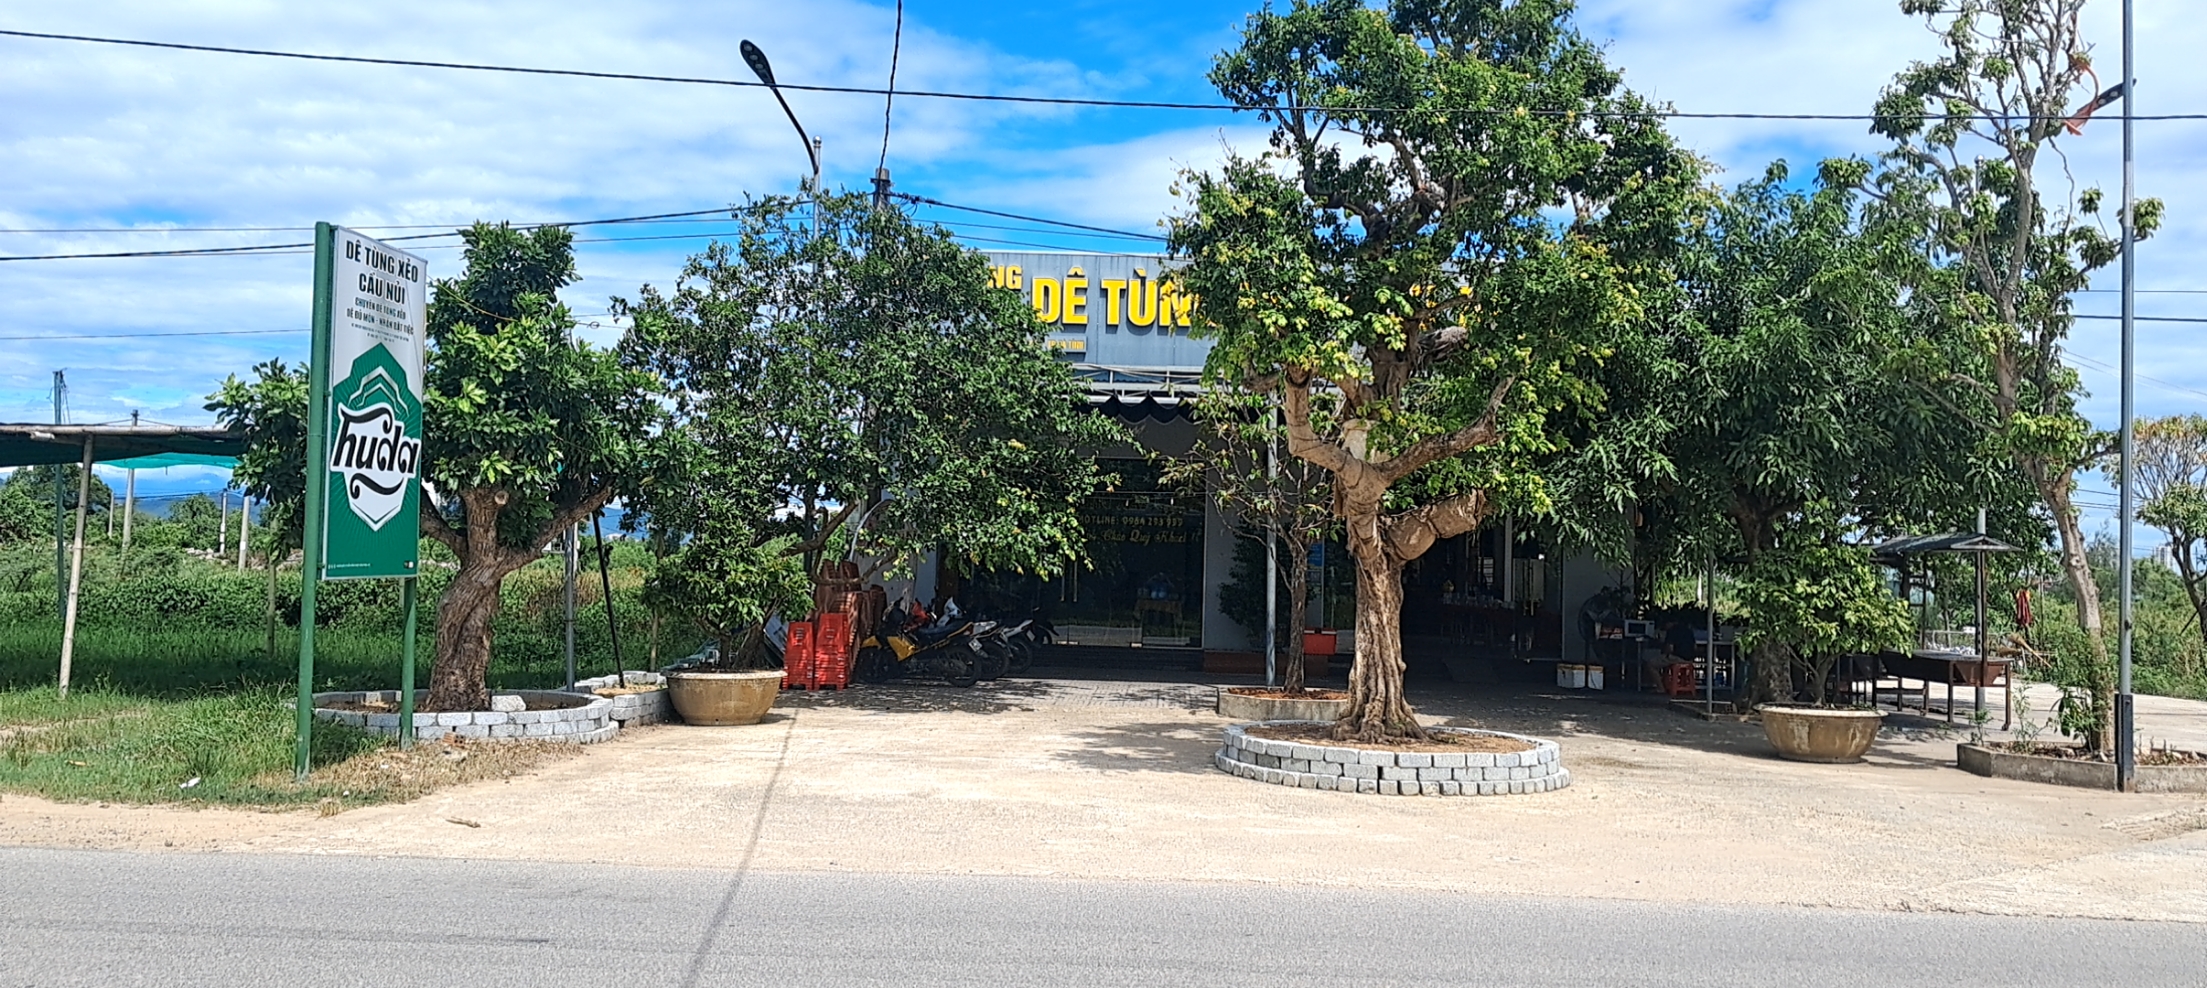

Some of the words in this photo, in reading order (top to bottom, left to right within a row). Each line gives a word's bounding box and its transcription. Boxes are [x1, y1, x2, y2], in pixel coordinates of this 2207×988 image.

[346, 239, 361, 263] DÊ
[364, 245, 395, 274] TÙNG
[1032, 266, 1088, 325] DÊ
[1101, 268, 1212, 328] TÙN
[333, 406, 419, 475] huda
